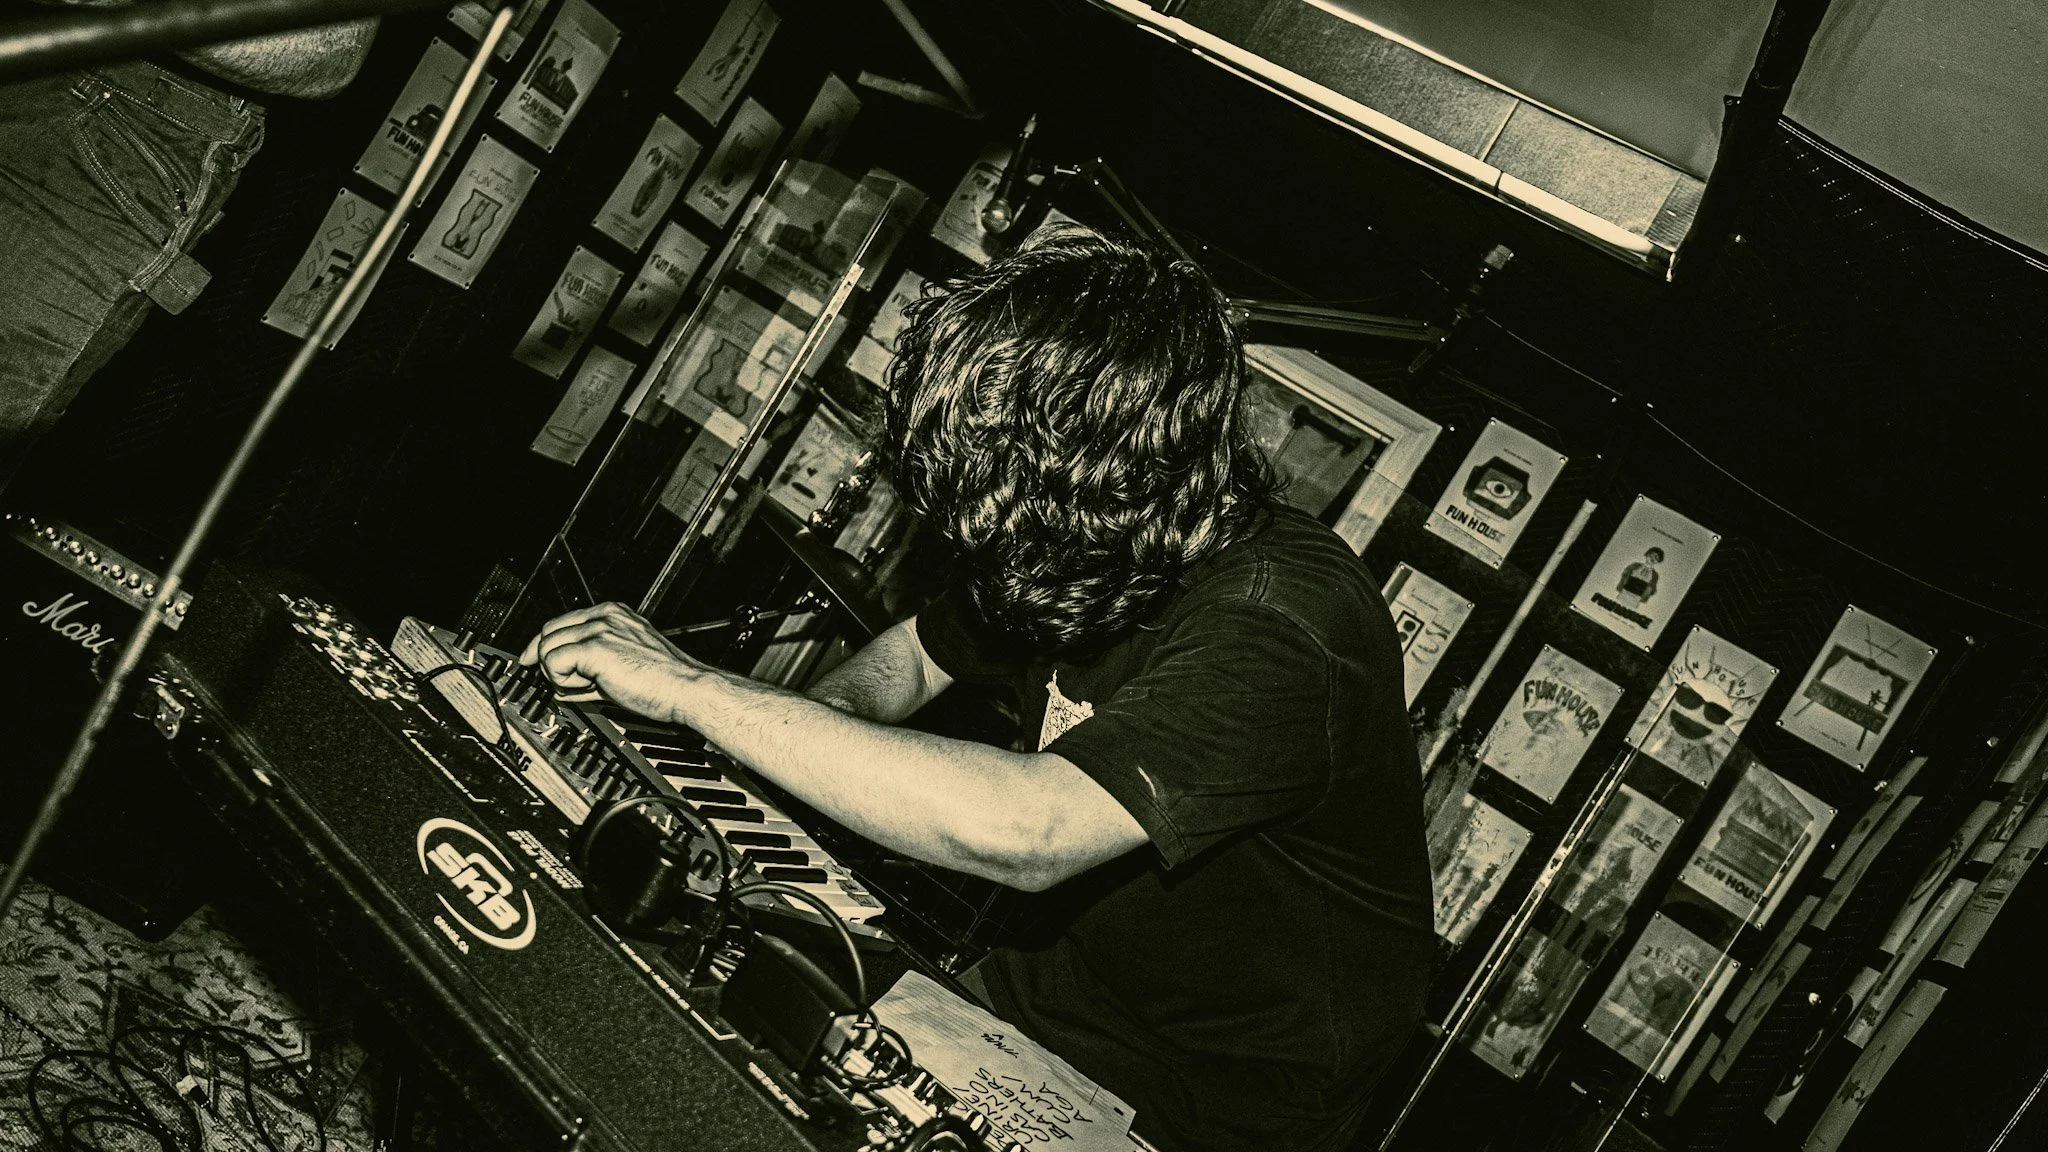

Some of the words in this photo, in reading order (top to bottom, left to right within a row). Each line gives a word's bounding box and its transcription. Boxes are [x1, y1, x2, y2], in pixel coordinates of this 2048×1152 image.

[386, 126, 409, 149] FUN
[1445, 504, 1469, 524] FUN
[1671, 661, 1699, 674] FUN
[1713, 664, 1758, 707] HOUSE
[1809, 683, 1837, 710] FUN
[1523, 676, 1558, 709] FUN
[1555, 686, 1600, 738] HOUSE
[427, 842, 521, 931] SKB
[1694, 856, 1727, 882] FUN
[969, 1081, 1050, 1142] CASINO
[975, 1067, 1074, 1140] BATHERS
[1039, 1081, 1093, 1123] AGA
